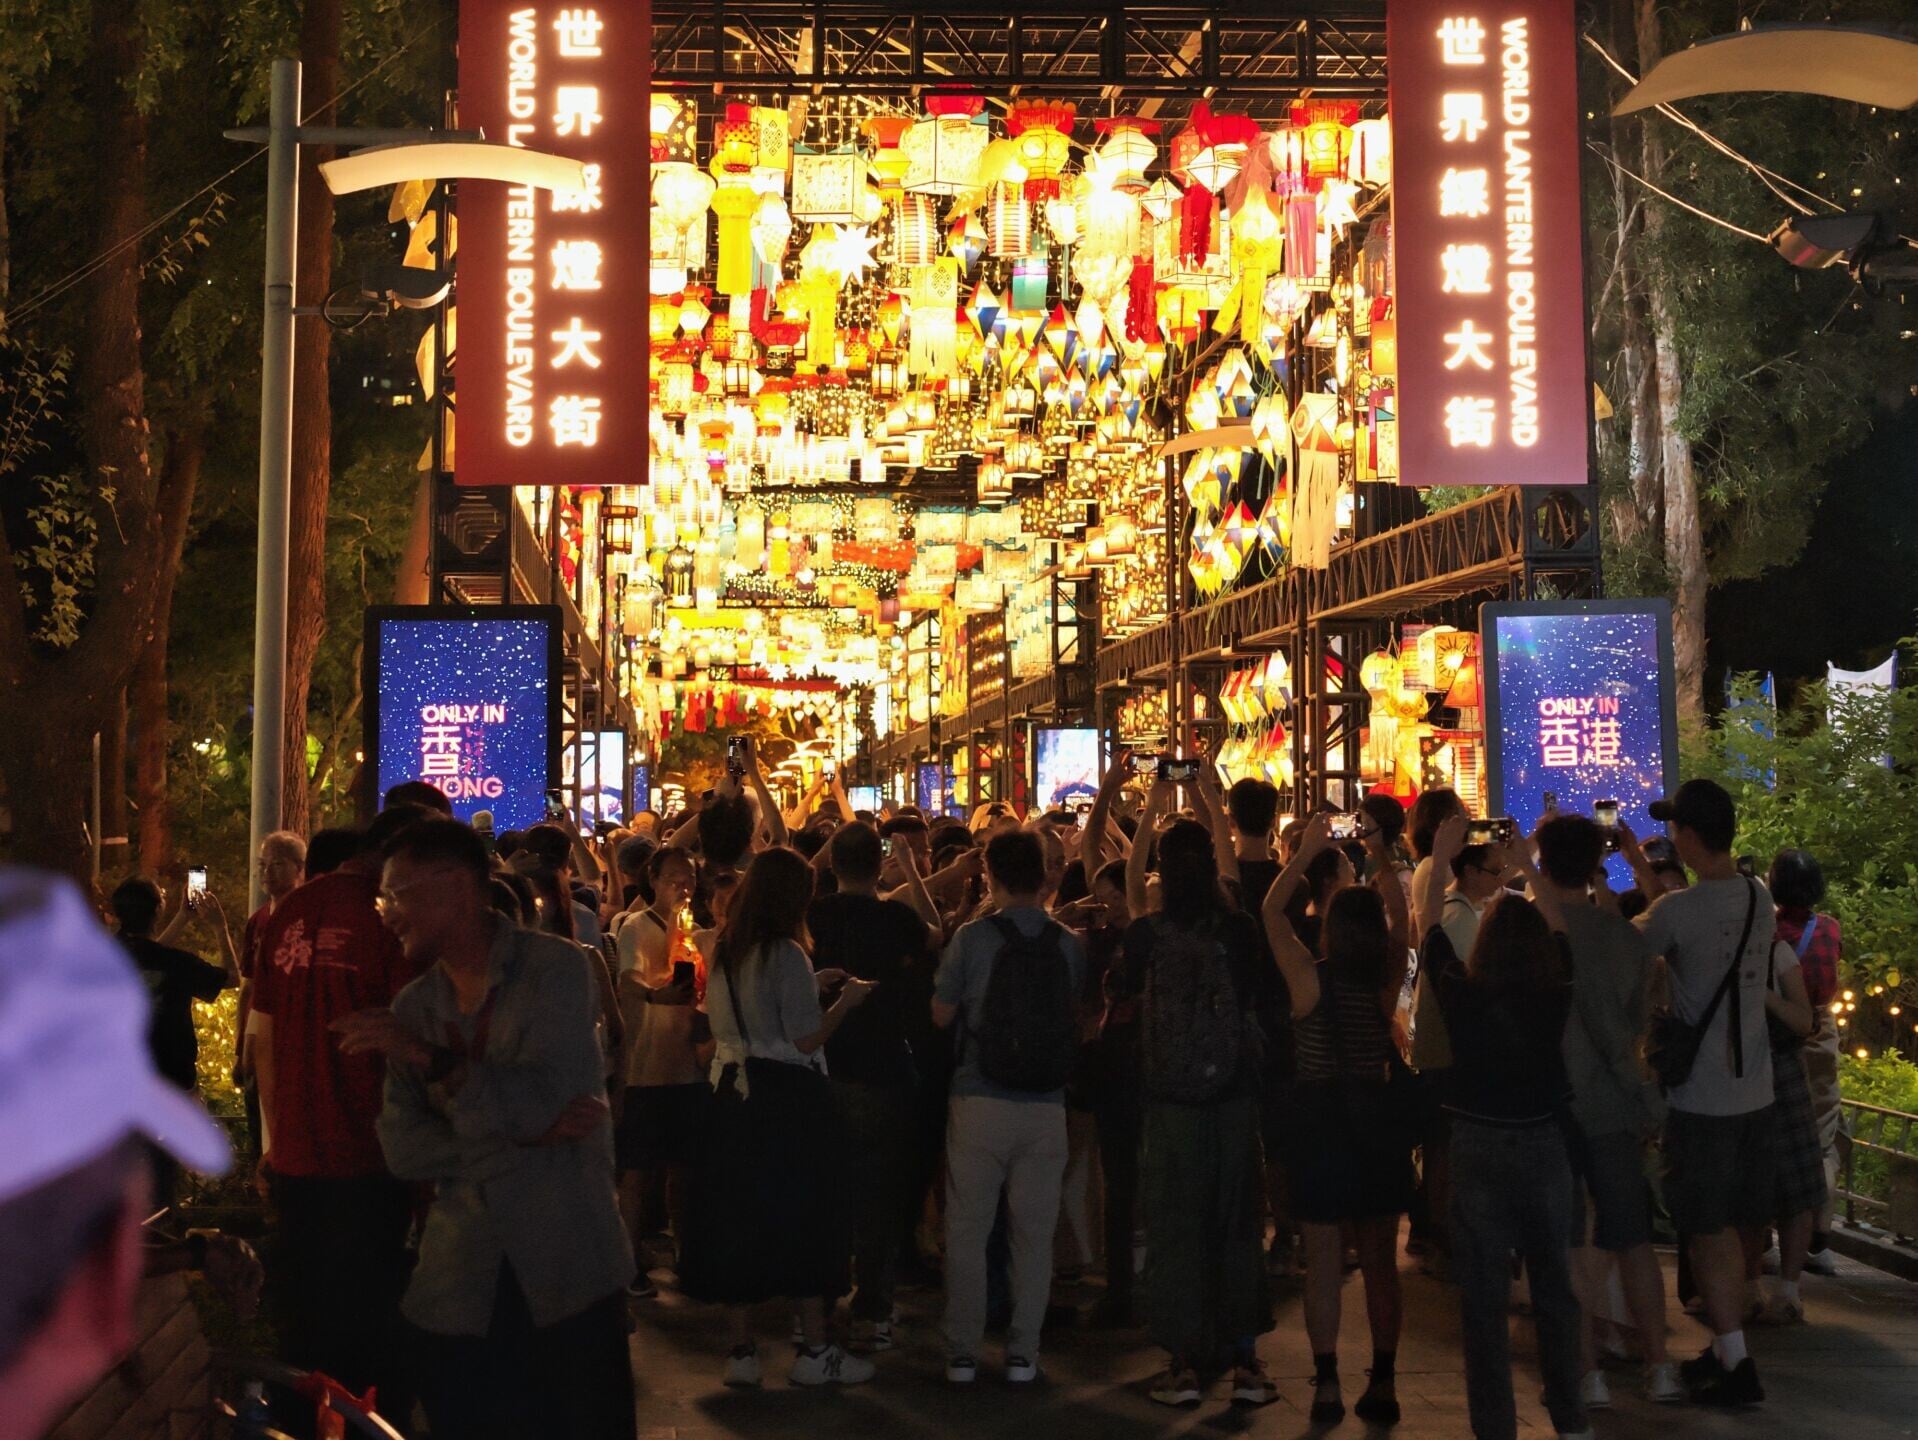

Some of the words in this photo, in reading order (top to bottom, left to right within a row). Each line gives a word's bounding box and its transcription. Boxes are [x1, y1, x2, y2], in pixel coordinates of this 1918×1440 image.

[508, 8, 536, 119] WORLD
[1501, 17, 1530, 126] WORLD
[507, 124, 536, 261] LTERN
[1503, 130, 1534, 266] LANTERN
[505, 267, 534, 447] BOULEVARD
[1507, 270, 1539, 448] BOULEVARD
[422, 704, 479, 723] ONLY
[483, 704, 504, 723] IN
[1540, 697, 1594, 716] ONLY
[1598, 697, 1619, 715] IN
[1540, 717, 1621, 767] 香港
